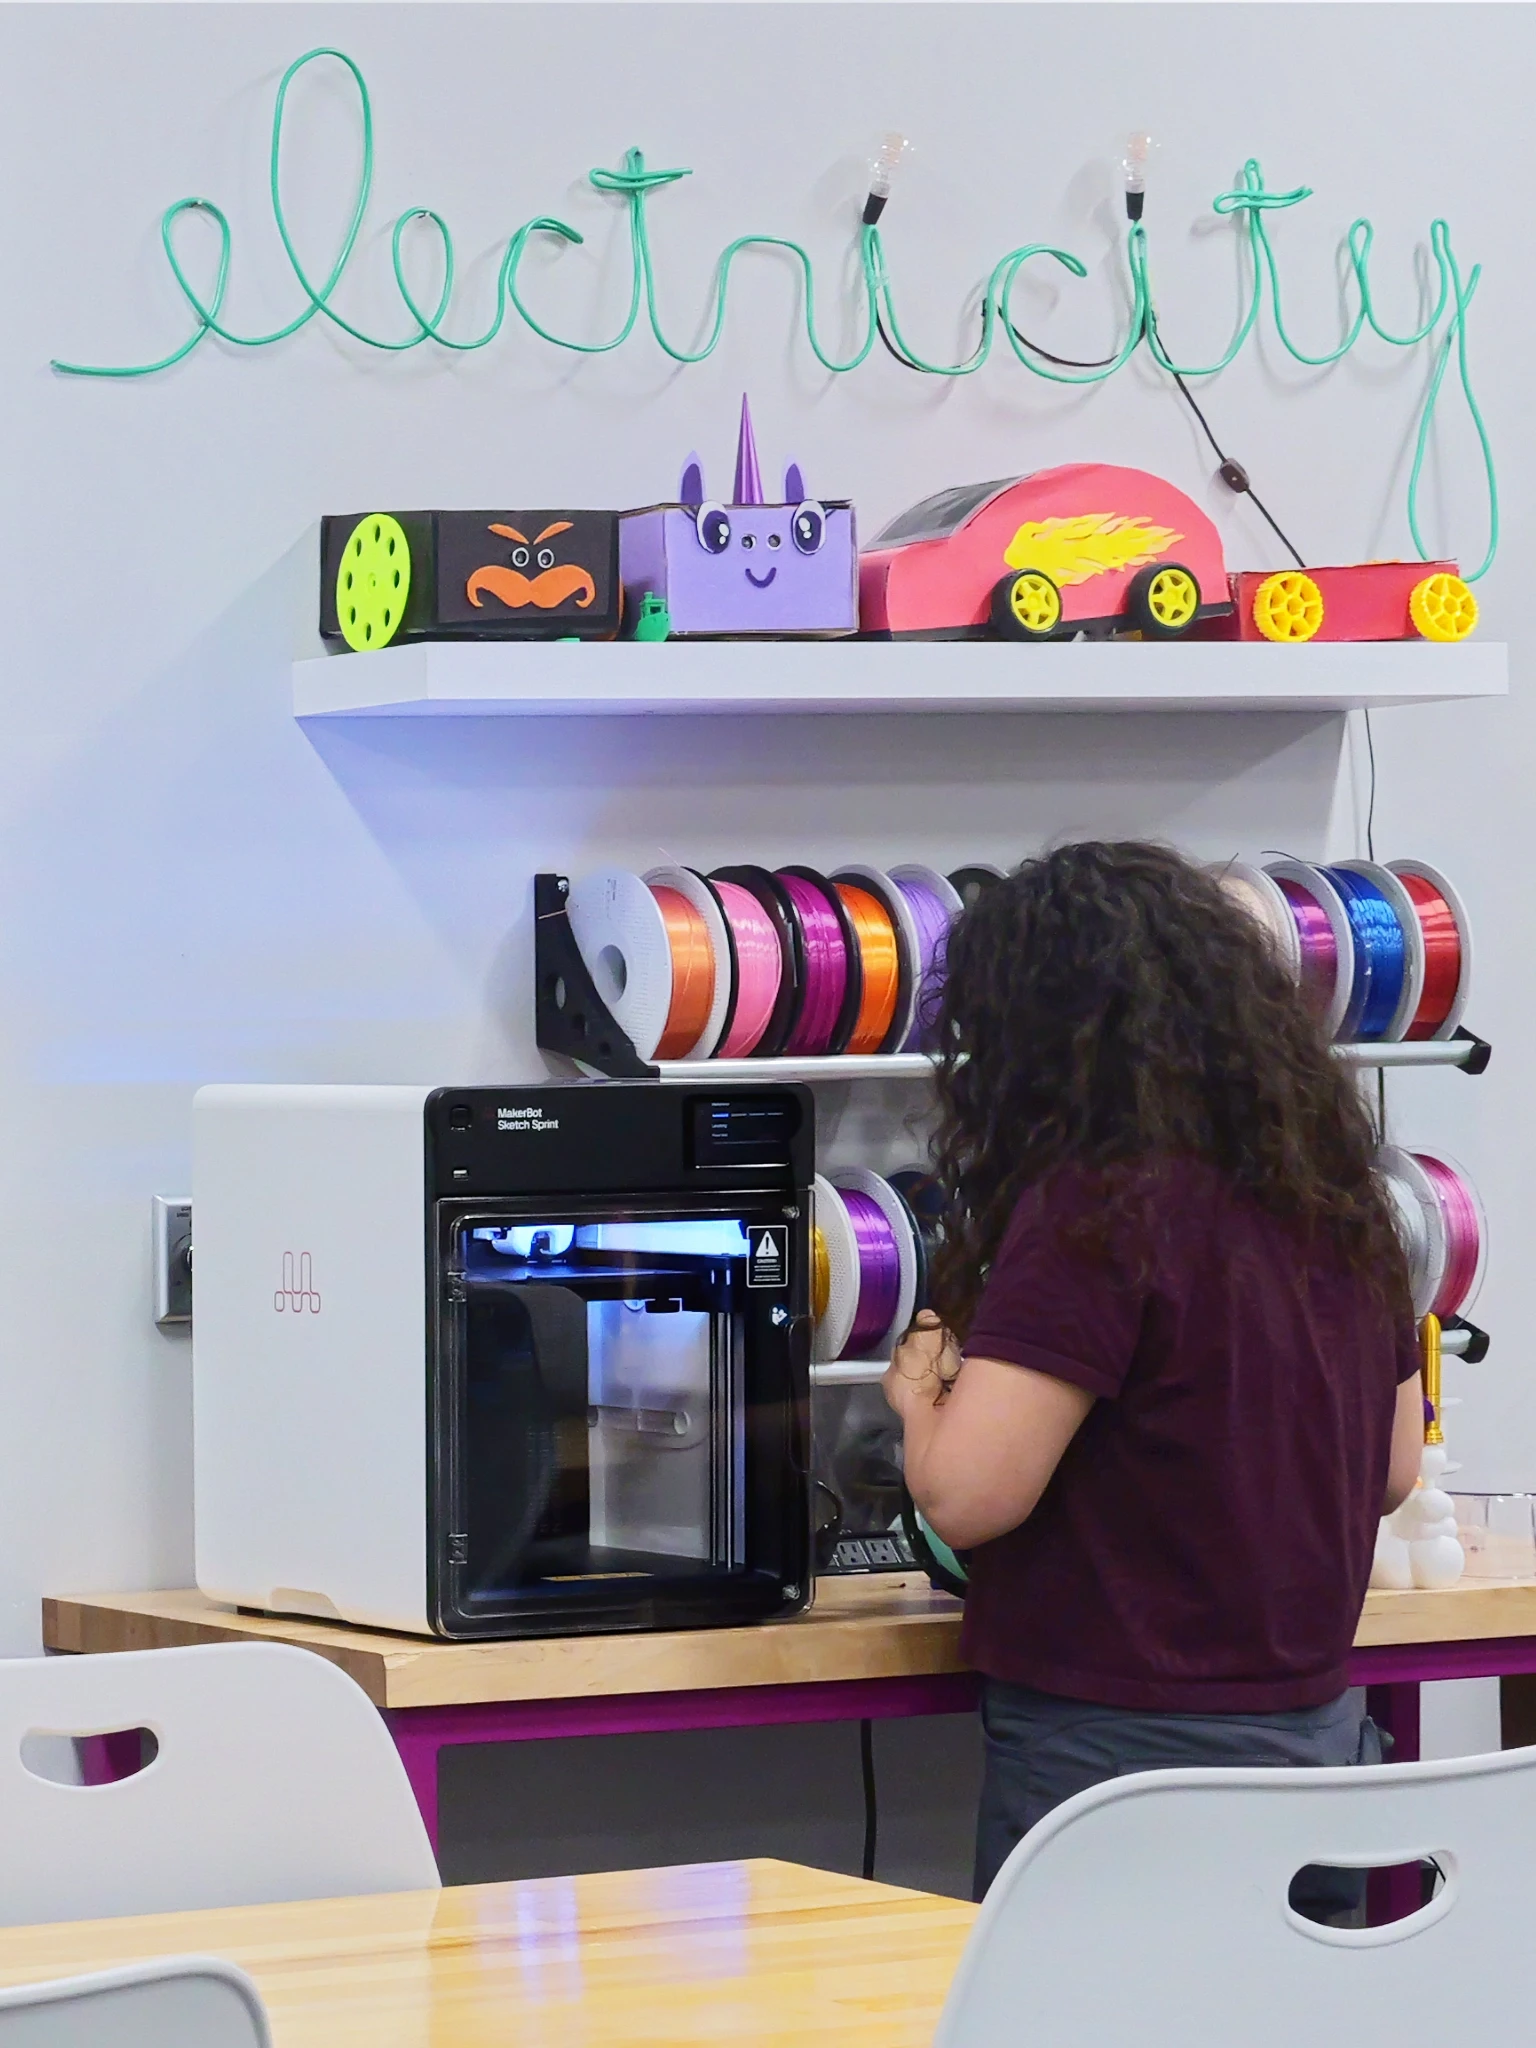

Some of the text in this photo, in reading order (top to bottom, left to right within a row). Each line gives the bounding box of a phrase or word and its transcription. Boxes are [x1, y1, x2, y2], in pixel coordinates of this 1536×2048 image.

[51, 48, 1497, 583] electricity
[497, 1107, 543, 1118] MakerBot
[497, 1119, 560, 1132] Sketch Sprint
